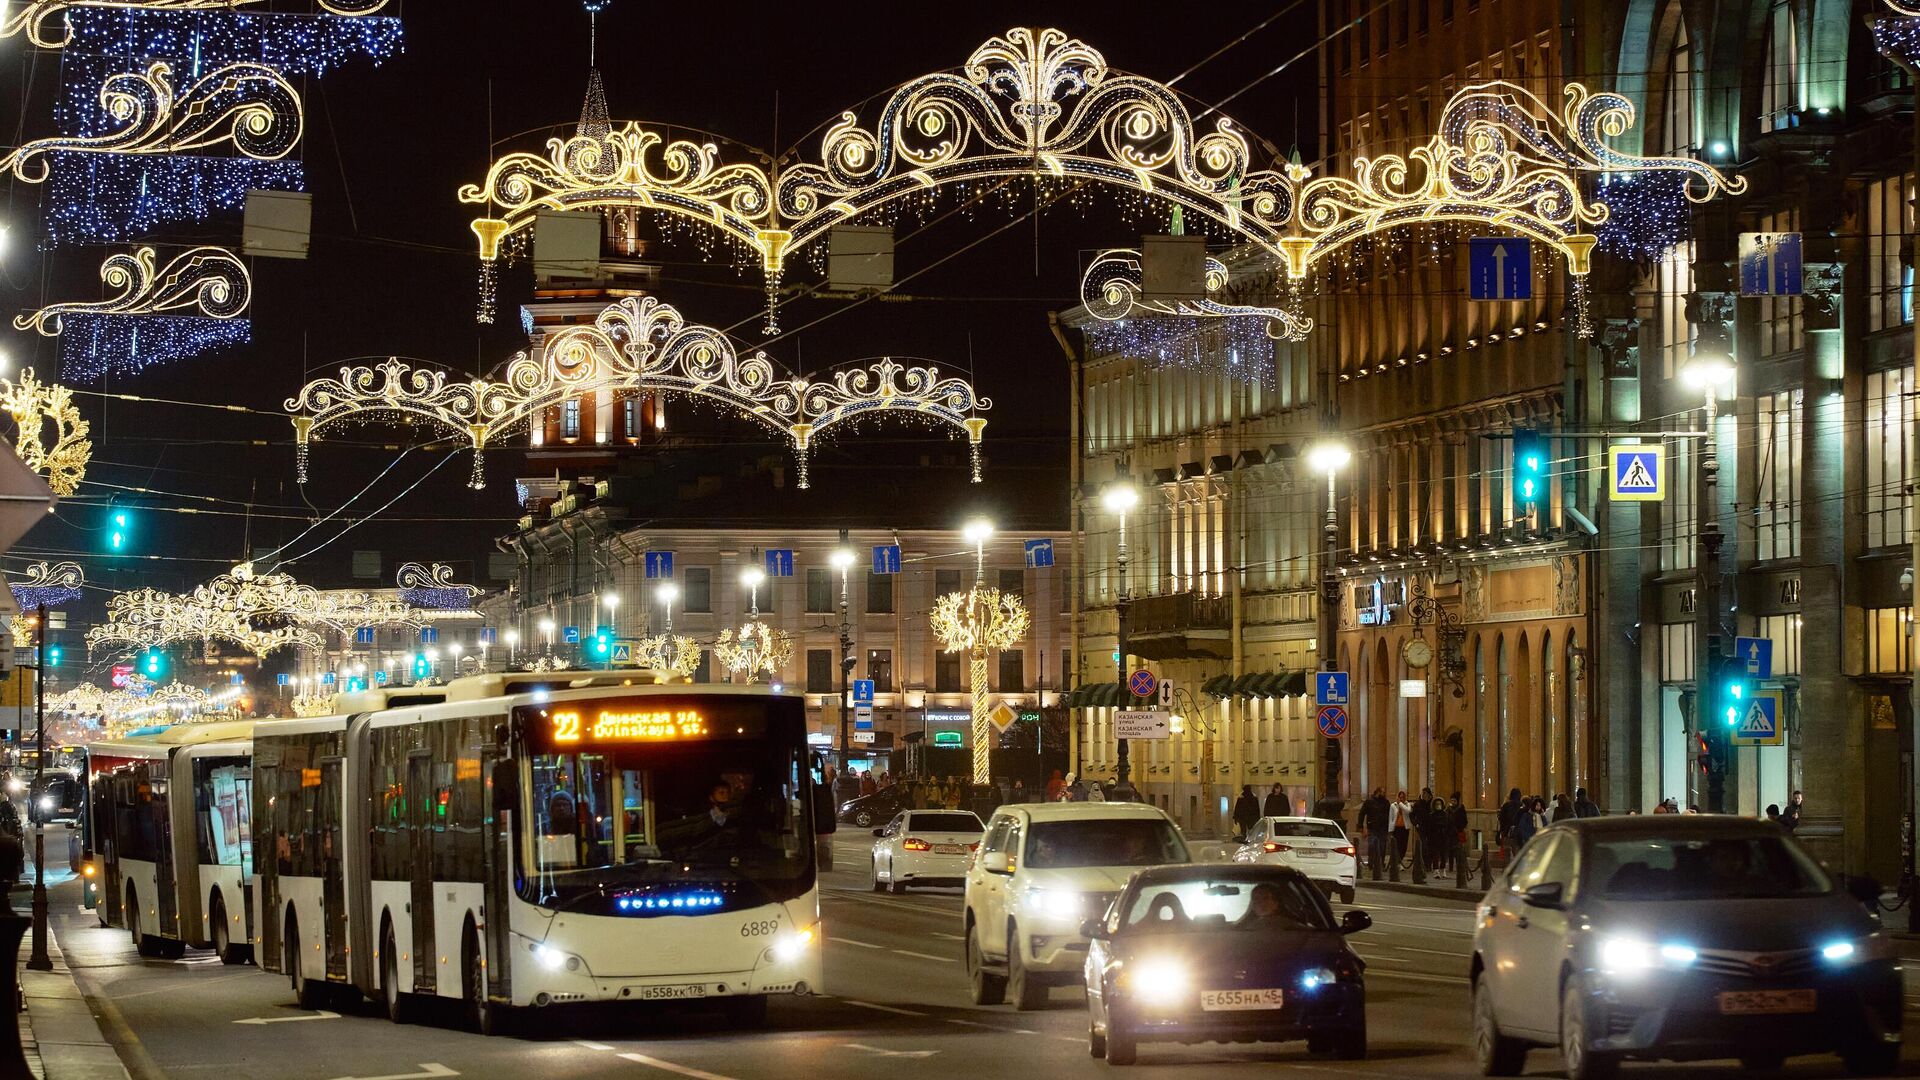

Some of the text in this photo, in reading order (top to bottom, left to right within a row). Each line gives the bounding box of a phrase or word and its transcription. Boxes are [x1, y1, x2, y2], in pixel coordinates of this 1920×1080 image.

[600, 711, 703, 725] Двинская ул.
[553, 712, 580, 741] 22
[594, 723, 708, 738] Dvinskaya st.
[741, 919, 778, 937] 6889
[645, 986, 686, 999] В558ХК
[1207, 990, 1277, 1006] Е655НА 45
